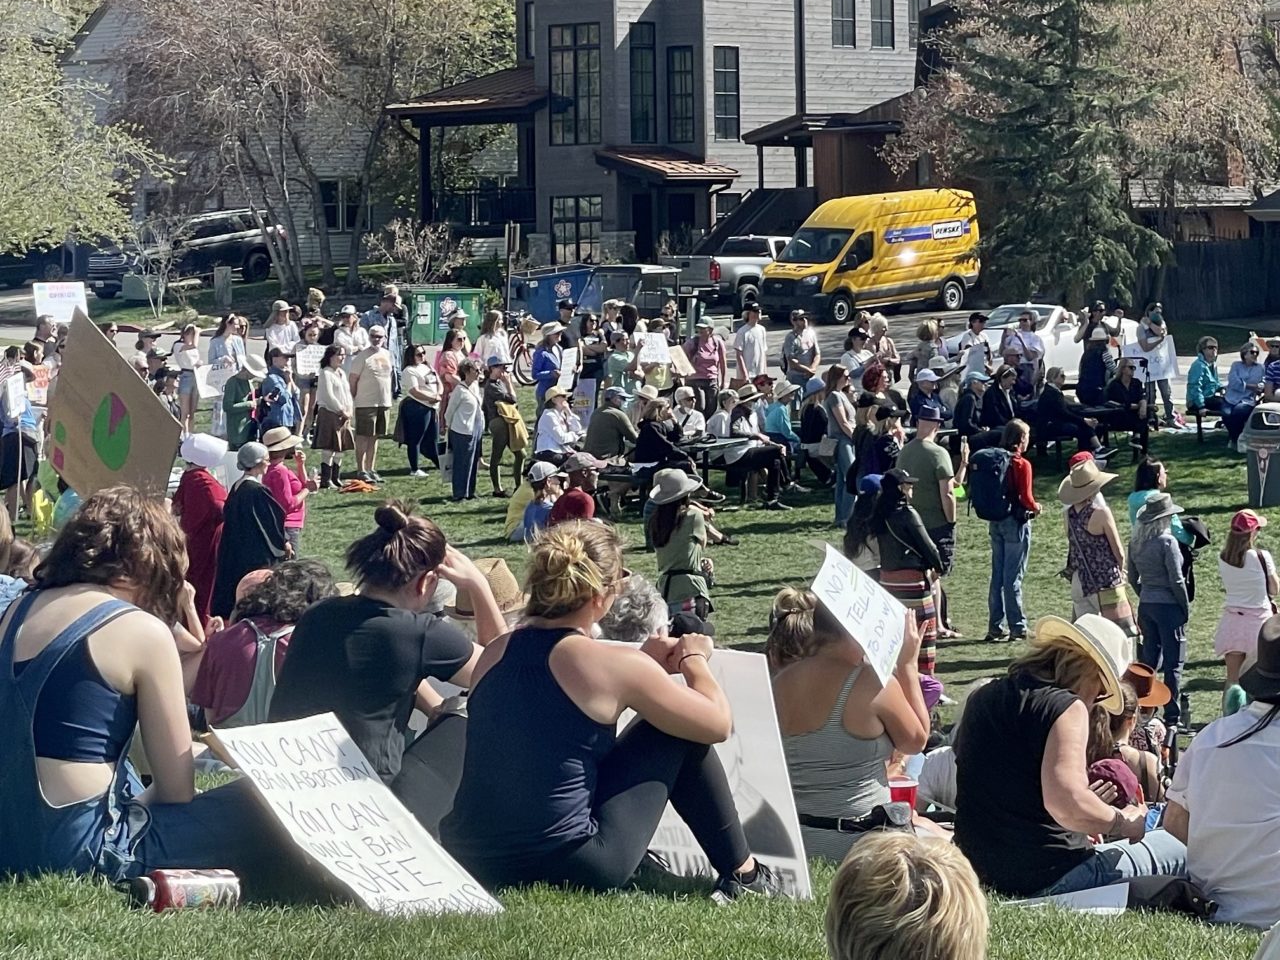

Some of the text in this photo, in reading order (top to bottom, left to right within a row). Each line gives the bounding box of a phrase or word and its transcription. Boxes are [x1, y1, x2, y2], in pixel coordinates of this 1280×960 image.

[935, 225, 960, 234] PENSKE
[225, 739, 278, 769] YOU
[295, 760, 374, 789] ABORTION
[276, 795, 390, 838] YOU CAN
[309, 830, 412, 860] ONLY BAN
[334, 855, 443, 895] SAFE
